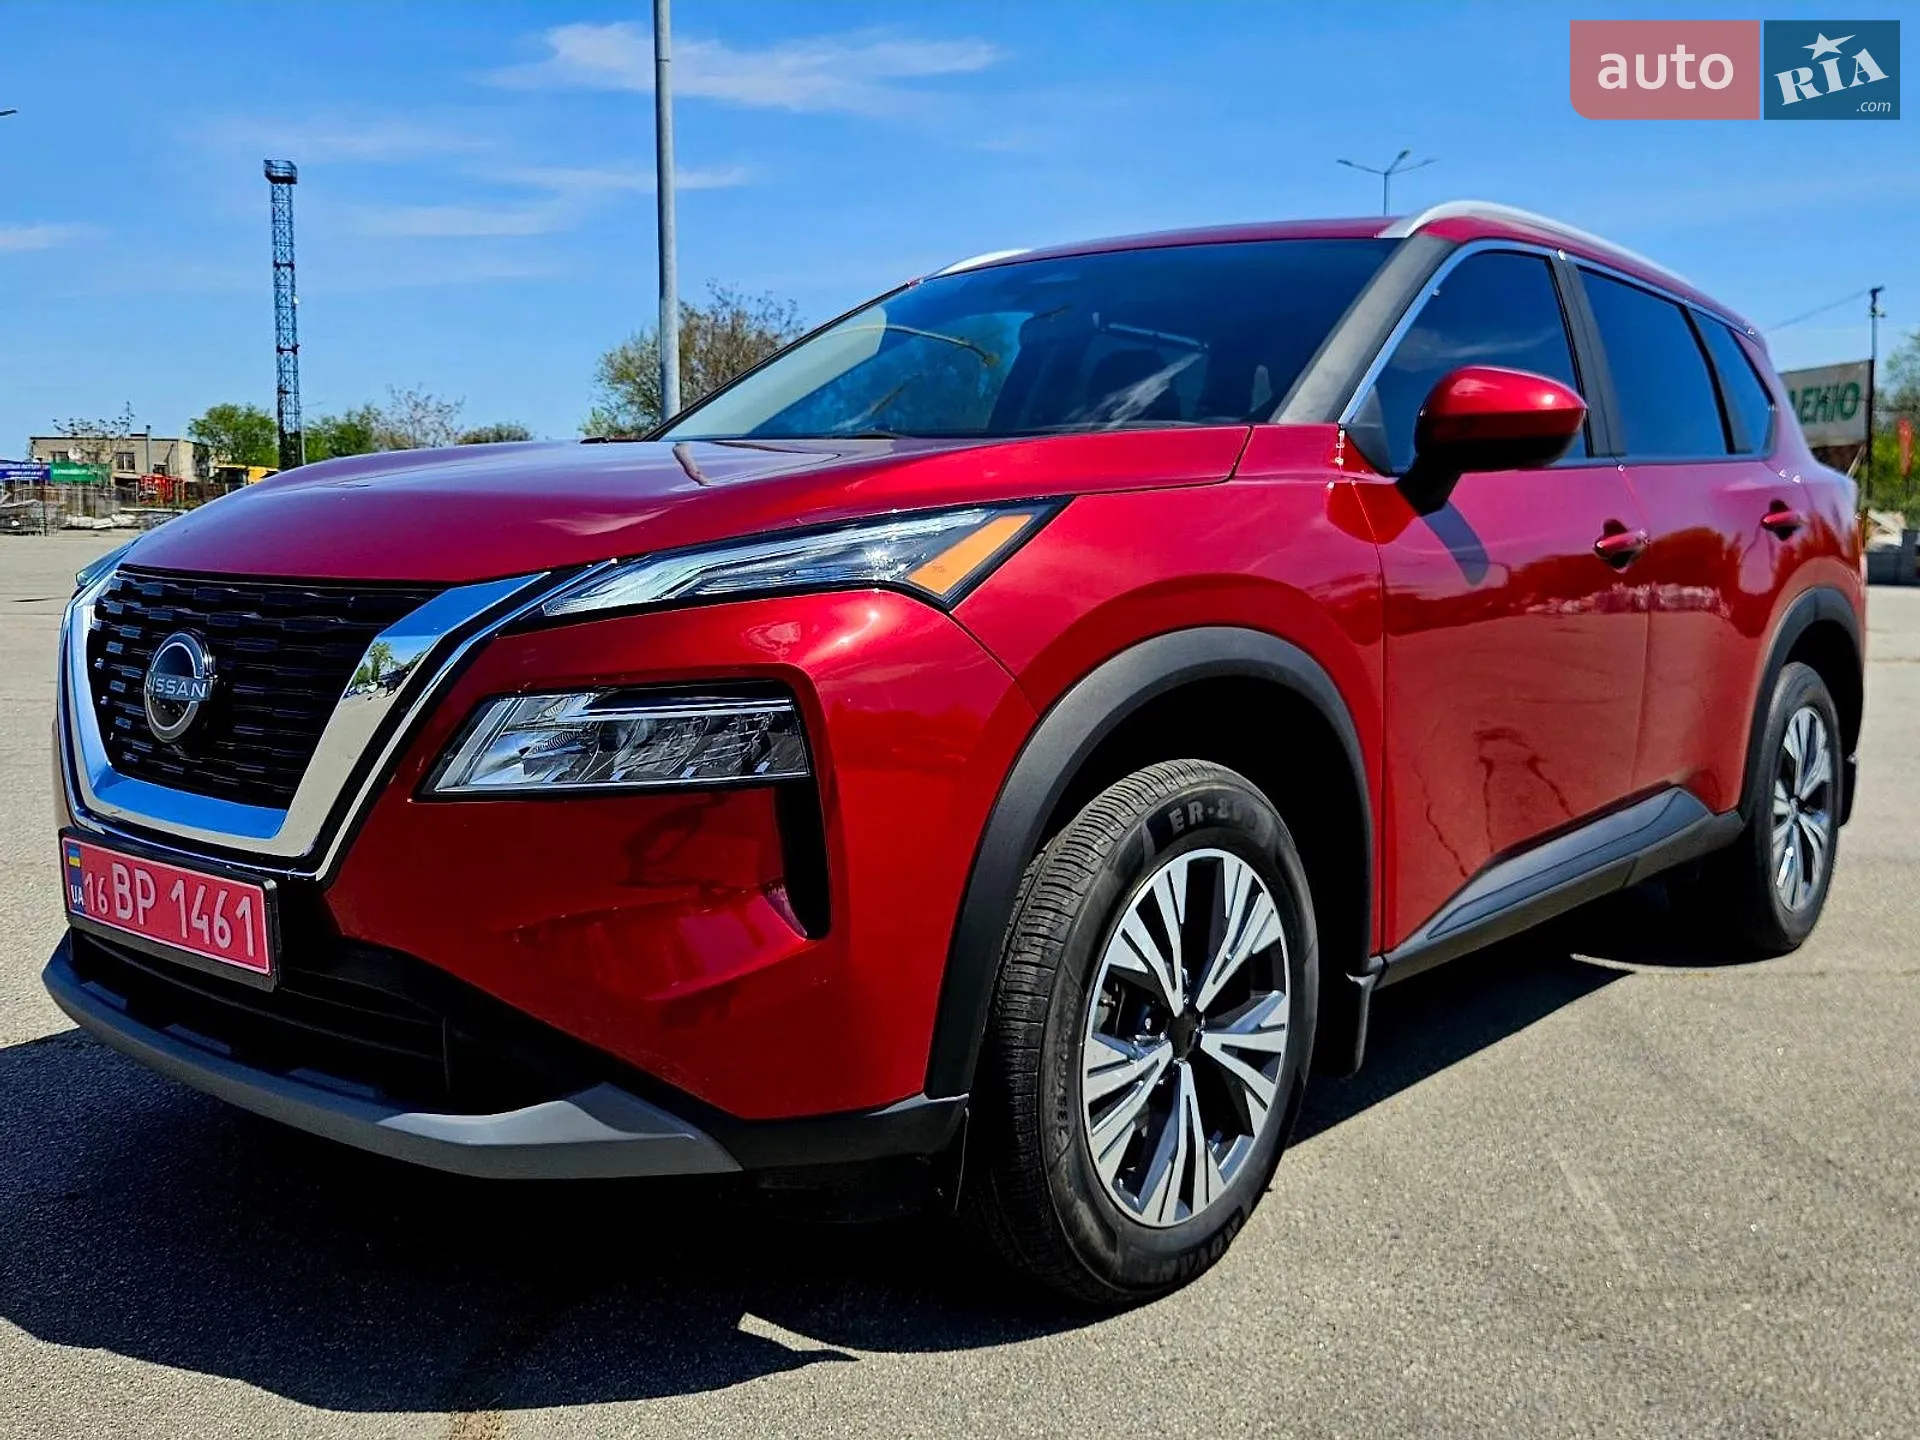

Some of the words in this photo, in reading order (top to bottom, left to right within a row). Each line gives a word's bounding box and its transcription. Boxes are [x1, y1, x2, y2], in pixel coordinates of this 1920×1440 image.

[145, 677, 207, 698] NISSAN
[70, 884, 84, 906] UA
[84, 872, 109, 914] 16
[111, 863, 157, 926] BP
[170, 879, 254, 957] 1461
